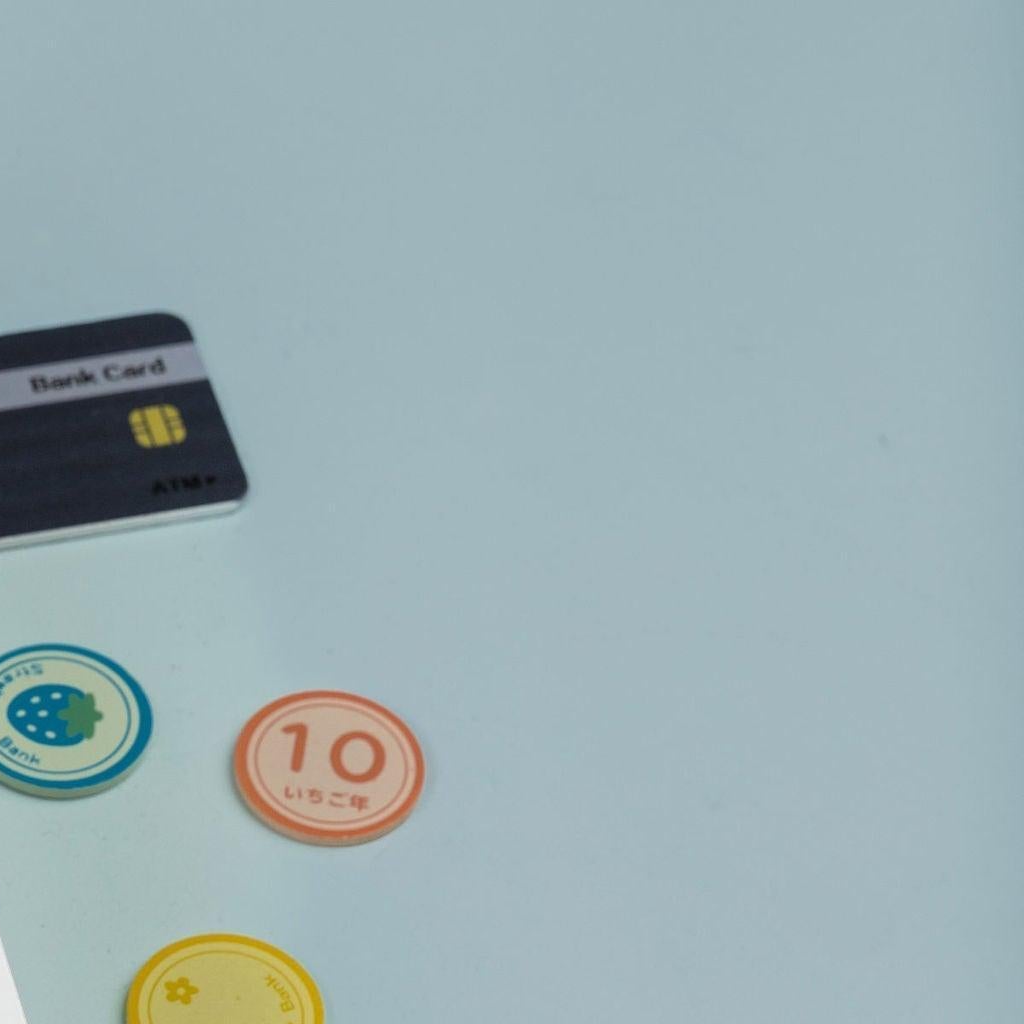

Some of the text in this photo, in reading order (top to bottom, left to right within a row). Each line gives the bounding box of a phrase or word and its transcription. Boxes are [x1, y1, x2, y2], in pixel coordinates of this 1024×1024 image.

[31, 355, 167, 394] Bank Card
[280, 722, 387, 784] 10
[264, 974, 295, 1013] Bank
